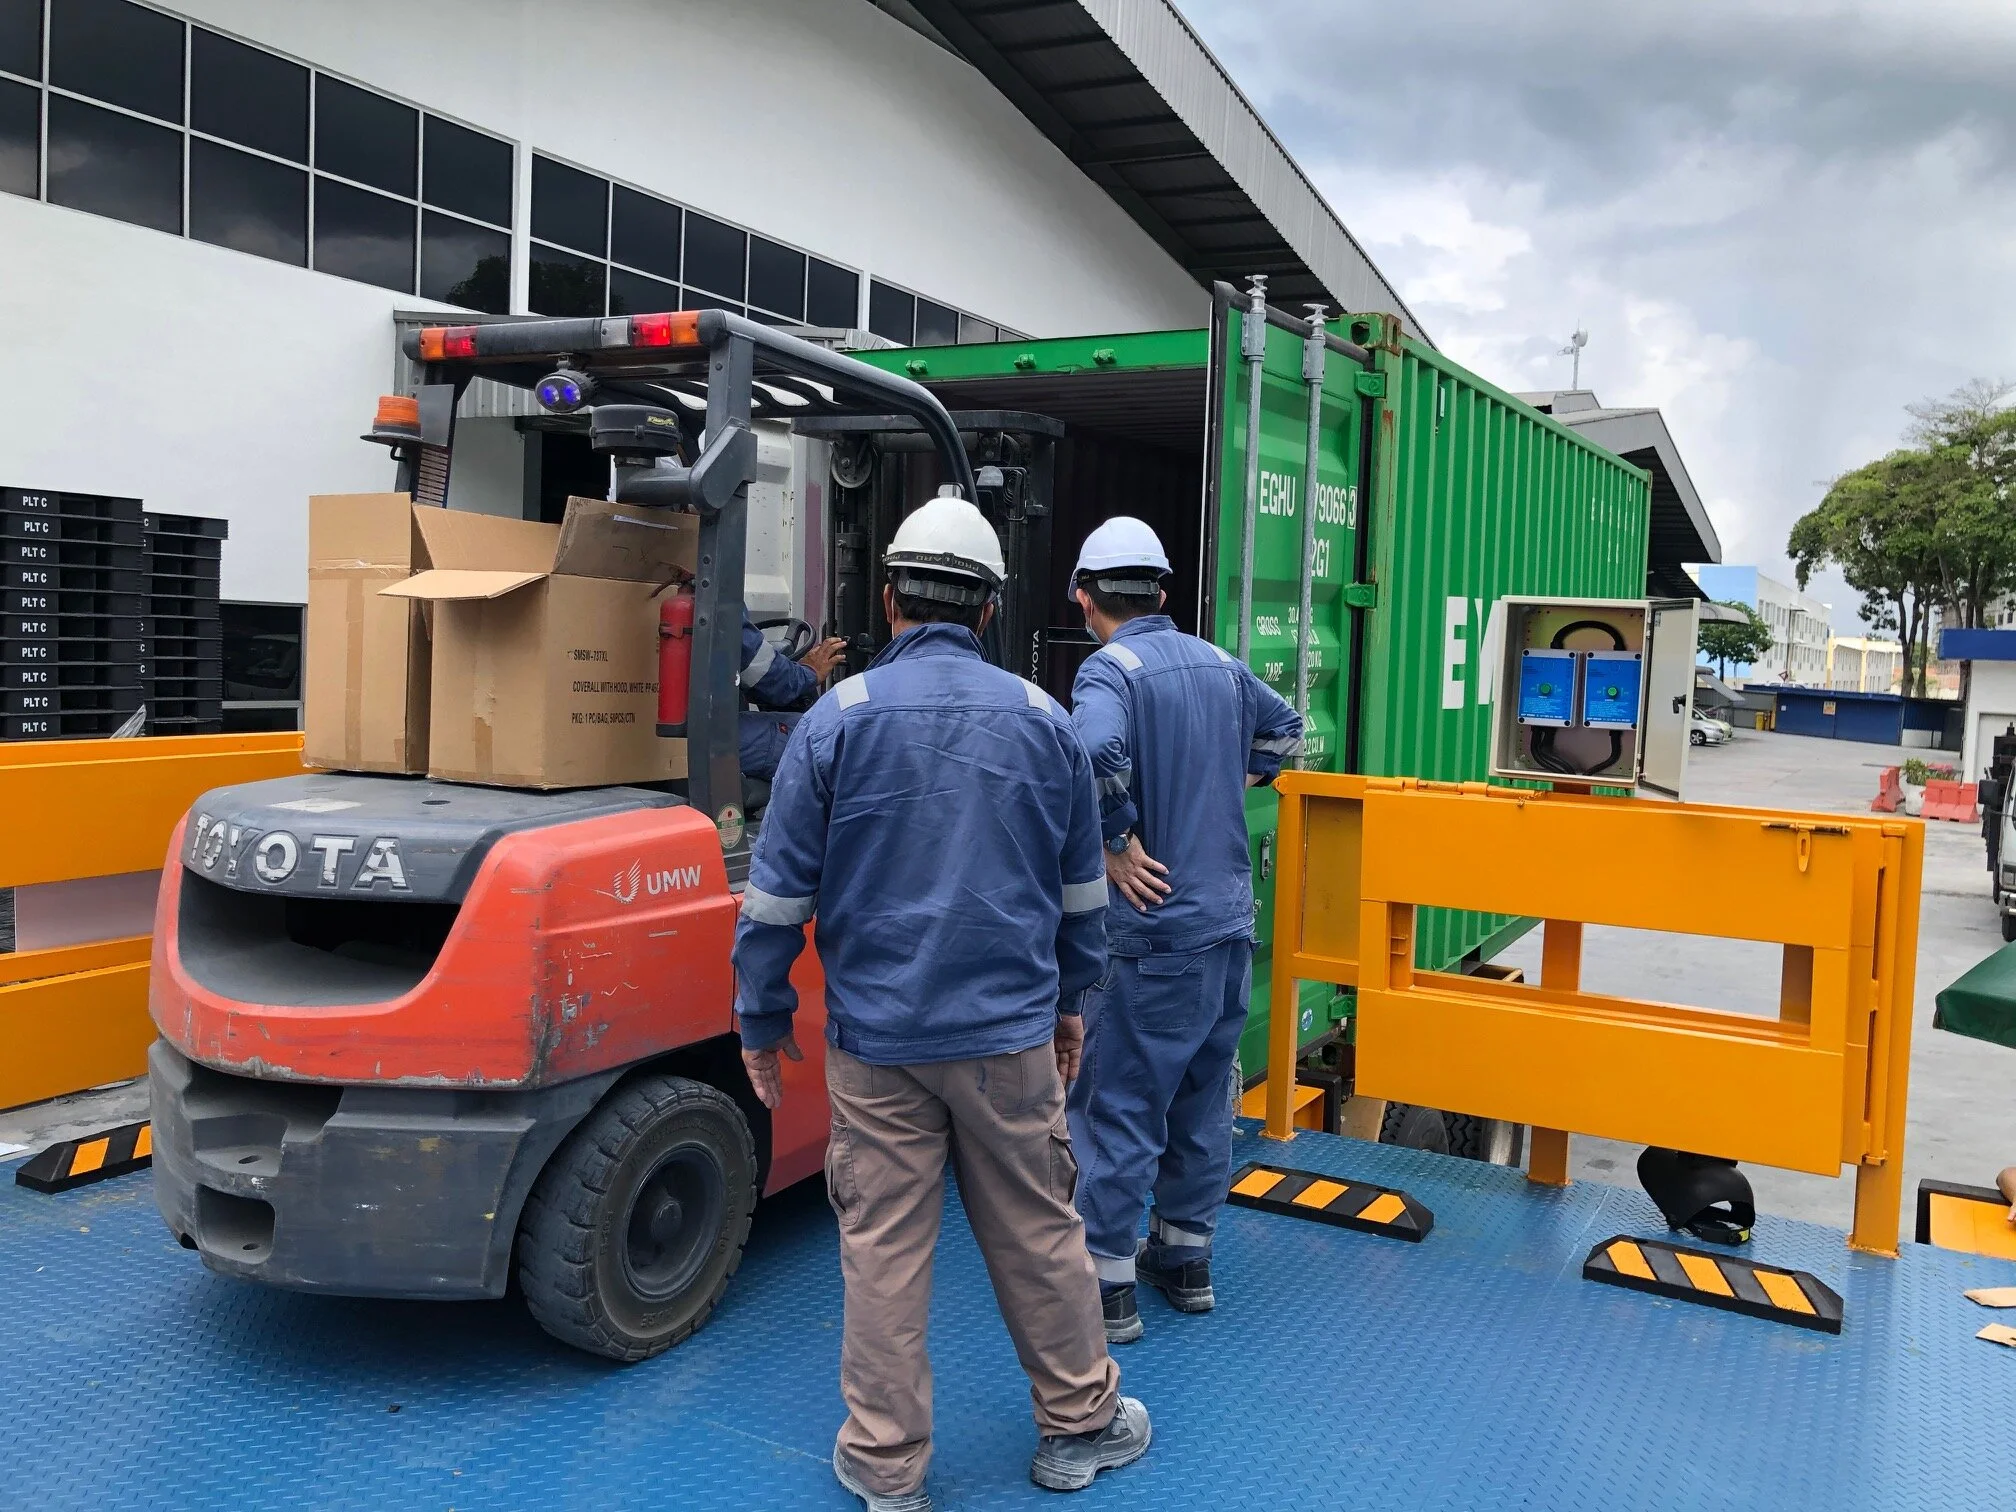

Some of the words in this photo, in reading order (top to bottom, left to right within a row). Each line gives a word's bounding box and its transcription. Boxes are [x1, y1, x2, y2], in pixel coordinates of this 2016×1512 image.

[22, 495, 40, 507] PLT
[41, 497, 48, 508] C
[1260, 470, 1296, 517] EGHU
[1314, 482, 1347, 526] 79066
[24, 521, 41, 533] PLT
[42, 522, 49, 533] C
[22, 547, 39, 558] PLT
[40, 547, 47, 558] C
[22, 572, 39, 583] PLT
[40, 572, 47, 584] C
[22, 597, 39, 608] PLT
[40, 597, 47, 608] C
[22, 622, 39, 633] PLT
[40, 622, 47, 633] C
[1256, 615, 1282, 636] GROSS
[22, 647, 39, 658] PLT
[40, 647, 47, 658] C
[1031, 629, 1040, 685] OYOTA
[22, 672, 39, 683] PLT
[40, 671, 47, 683] C
[572, 681, 600, 693] COVERALL
[23, 697, 41, 708] PLT
[41, 696, 49, 708] C
[22, 722, 39, 733] PLT
[40, 721, 47, 732] C
[189, 813, 411, 892] TOYOTA
[646, 864, 702, 895] UMW
